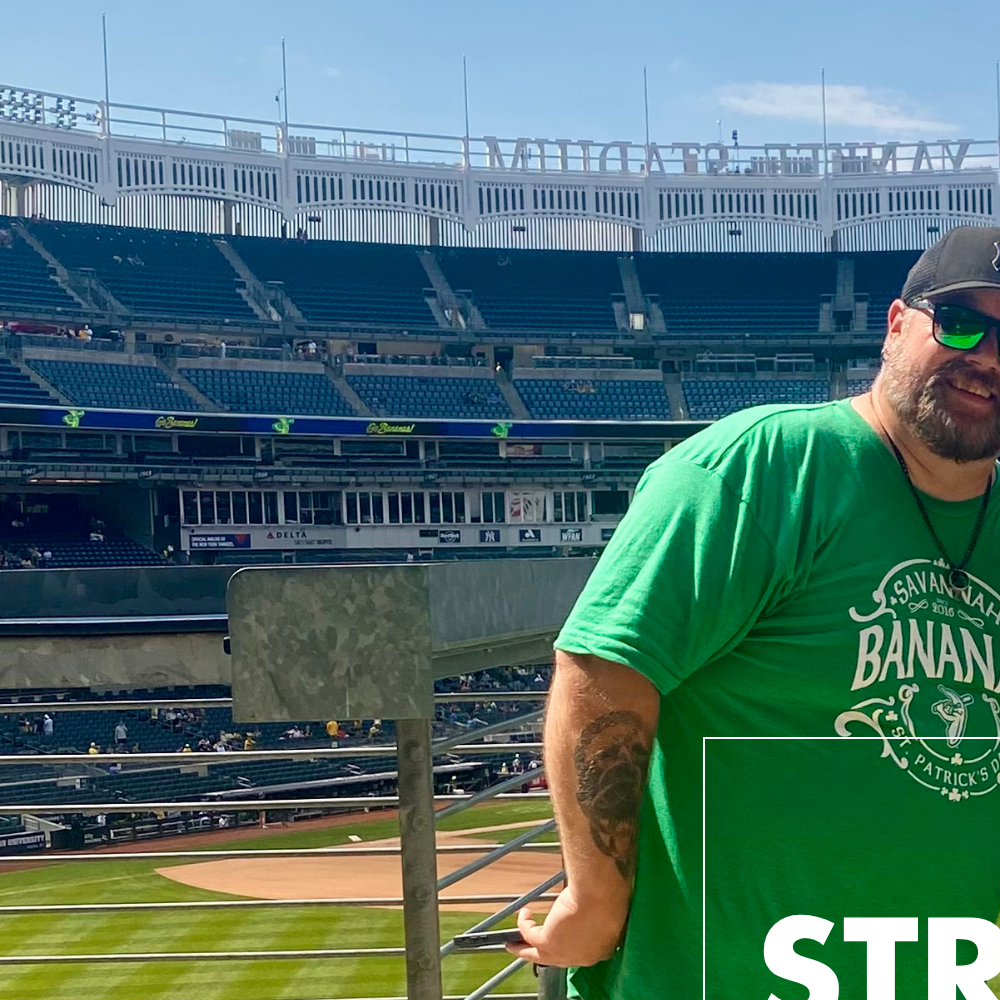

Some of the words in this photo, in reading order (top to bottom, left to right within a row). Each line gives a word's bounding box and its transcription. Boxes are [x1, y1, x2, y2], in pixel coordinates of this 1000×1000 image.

[276, 531, 307, 539] DELTA
[561, 531, 581, 541] WFAN
[931, 602, 955, 618] 2016
[914, 753, 989, 787] PATRICK'S
